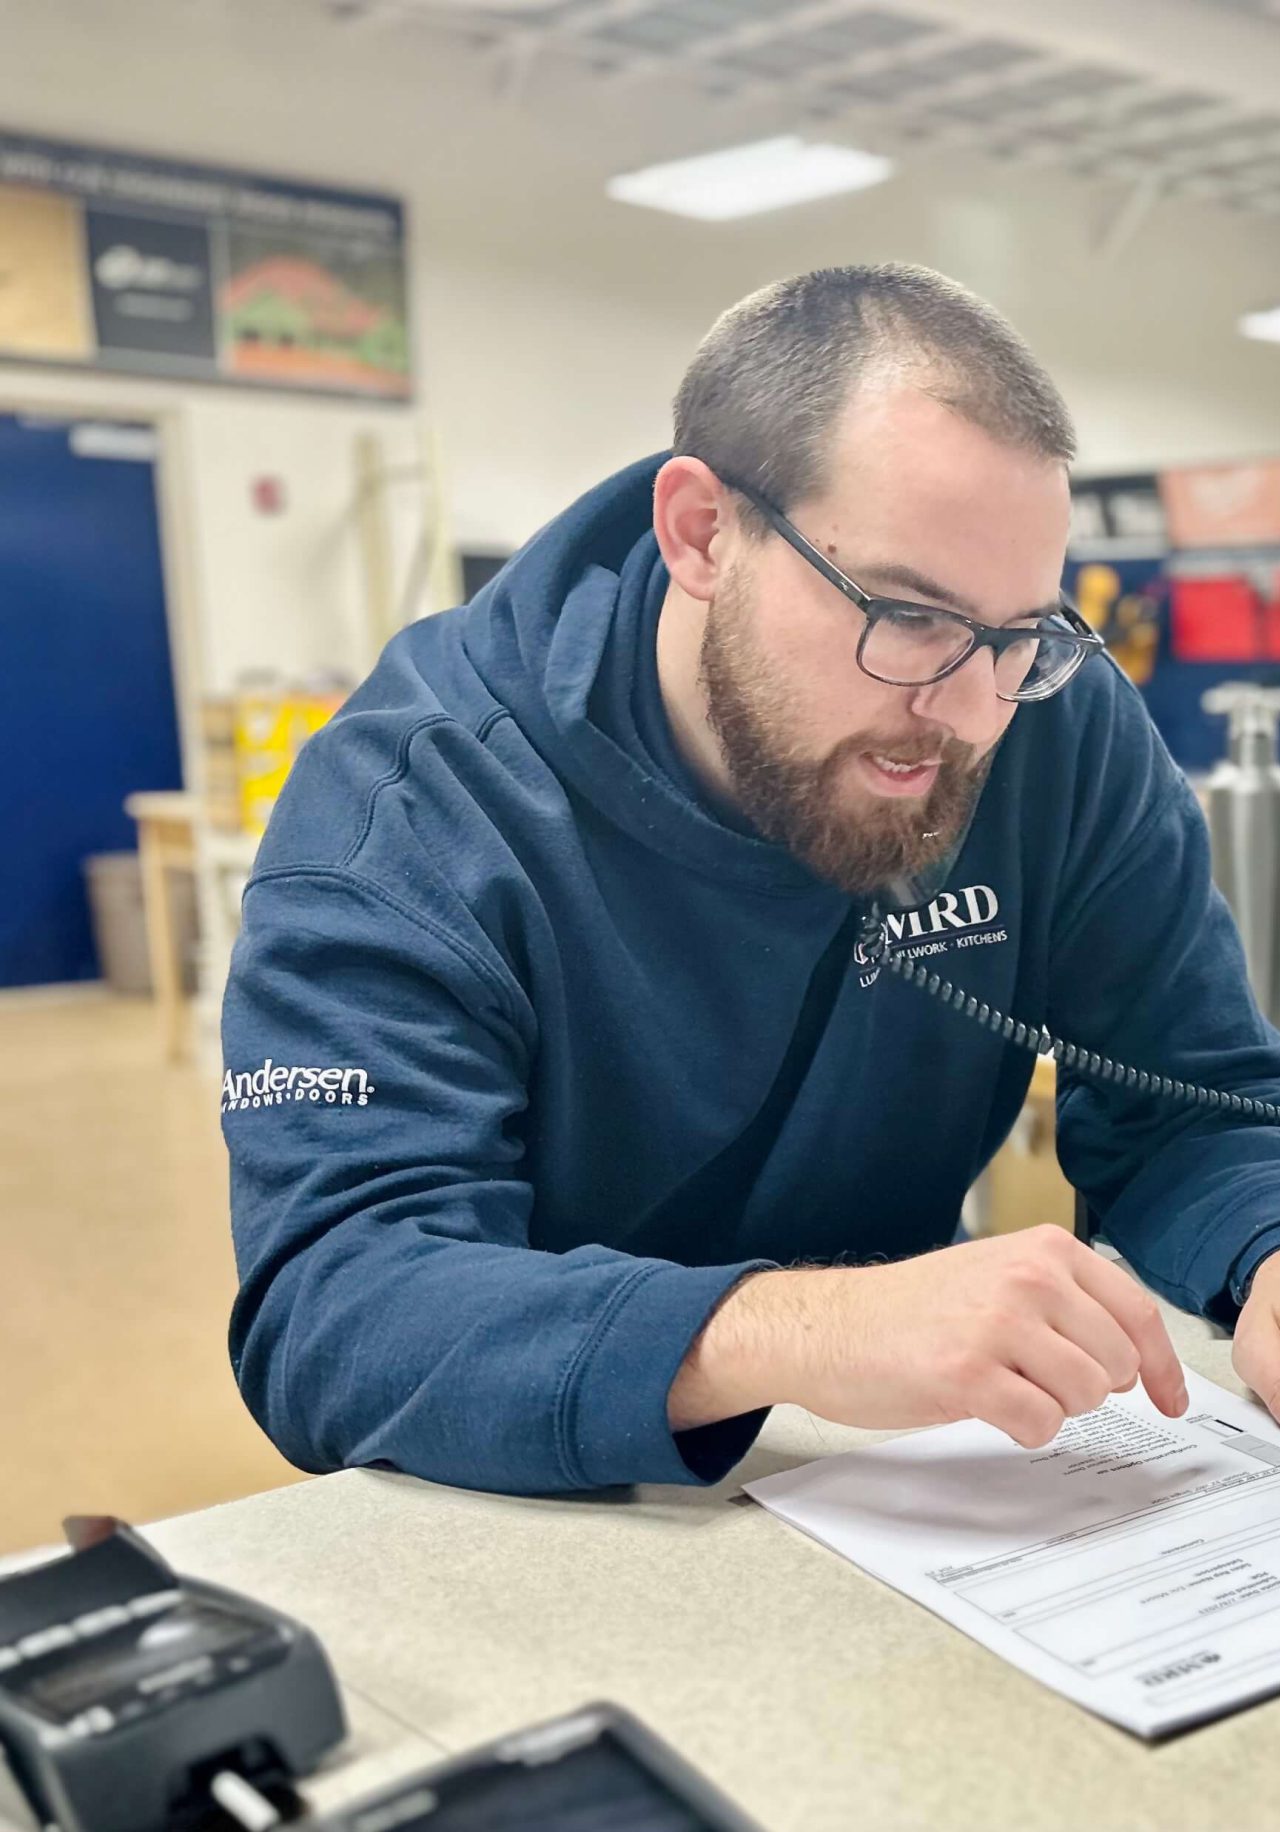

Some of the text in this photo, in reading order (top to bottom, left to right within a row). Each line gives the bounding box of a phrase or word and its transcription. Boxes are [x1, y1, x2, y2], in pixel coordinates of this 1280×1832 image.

[957, 930, 1008, 948] KITCHENS
[222, 1088, 368, 1113] INDOWS DOORS
